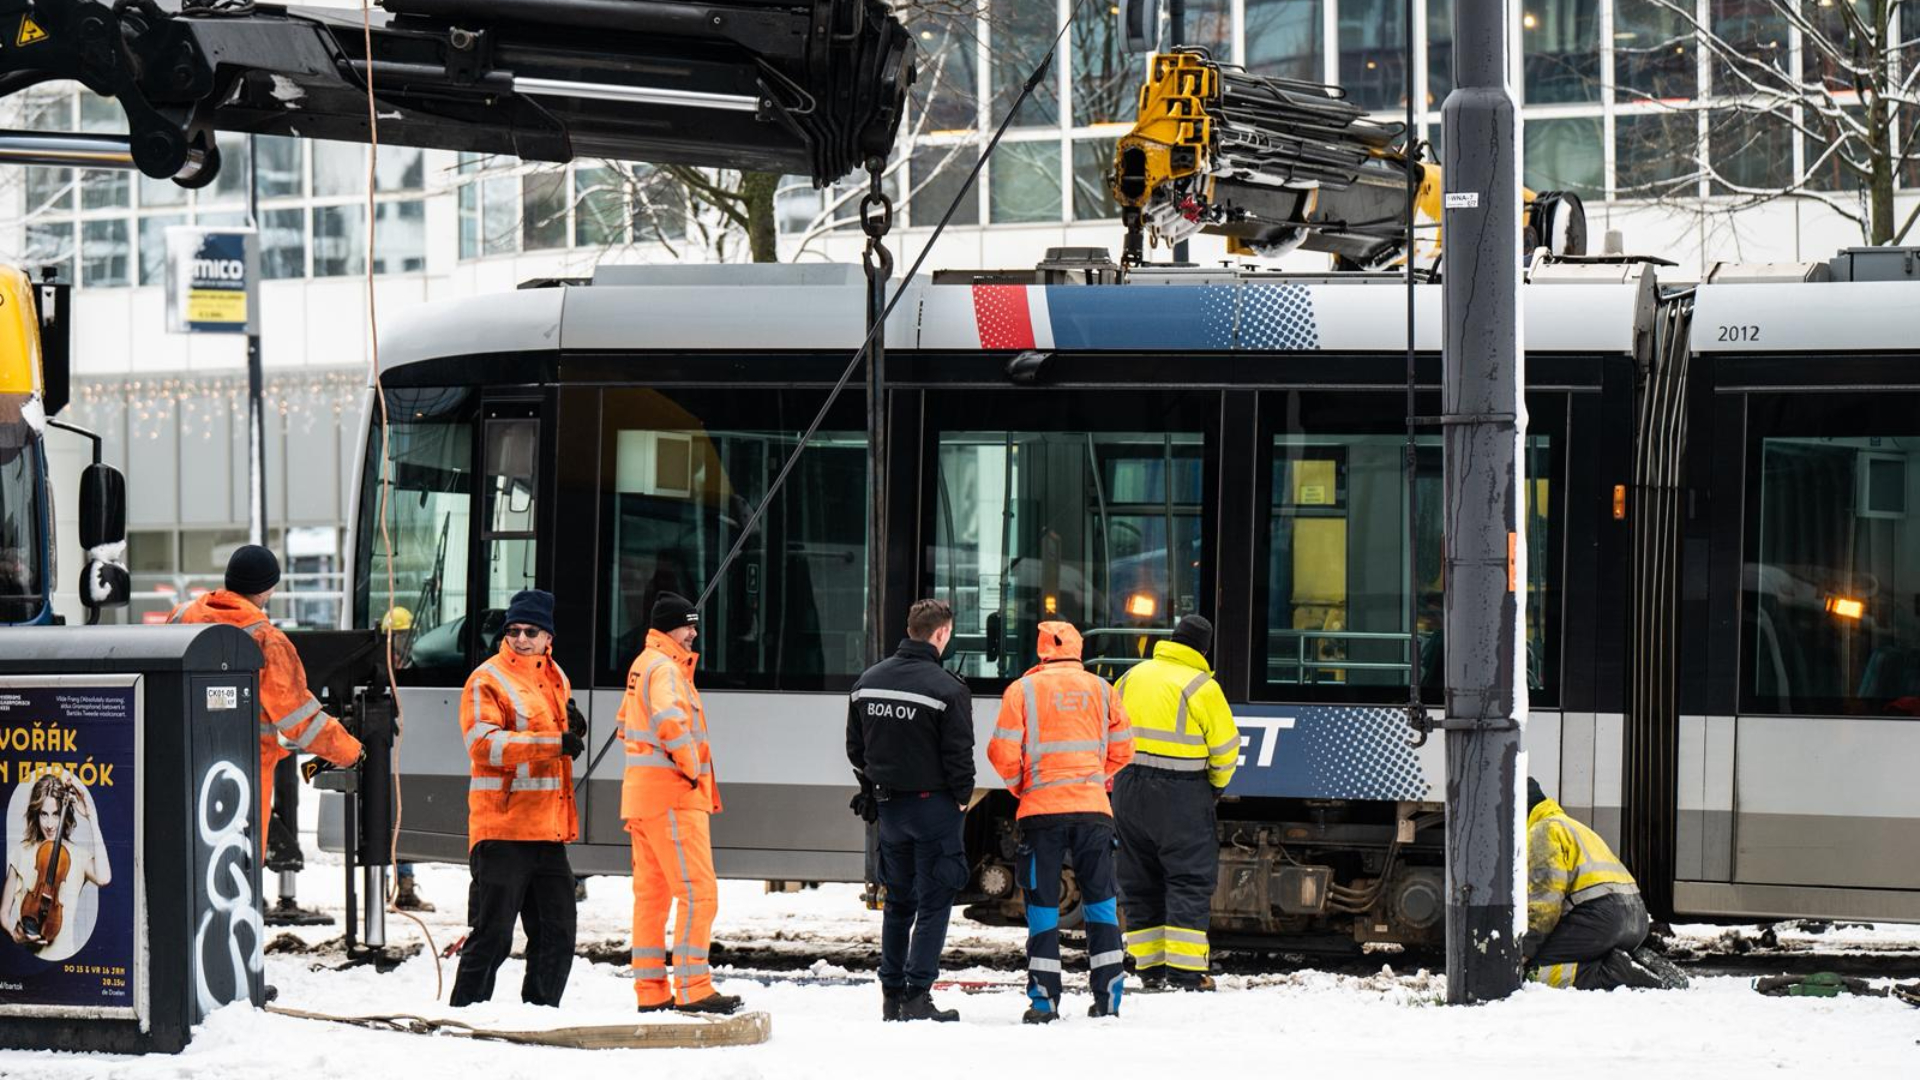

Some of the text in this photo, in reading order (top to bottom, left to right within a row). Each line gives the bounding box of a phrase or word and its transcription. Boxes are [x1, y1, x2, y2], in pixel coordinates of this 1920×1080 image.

[1717, 325, 1760, 342] 2012
[867, 702, 917, 721] BOA OV
[64, 965, 75, 973] DO
[76, 966, 83, 974] 15
[102, 967, 110, 975] 16
[111, 967, 125, 975] JAN
